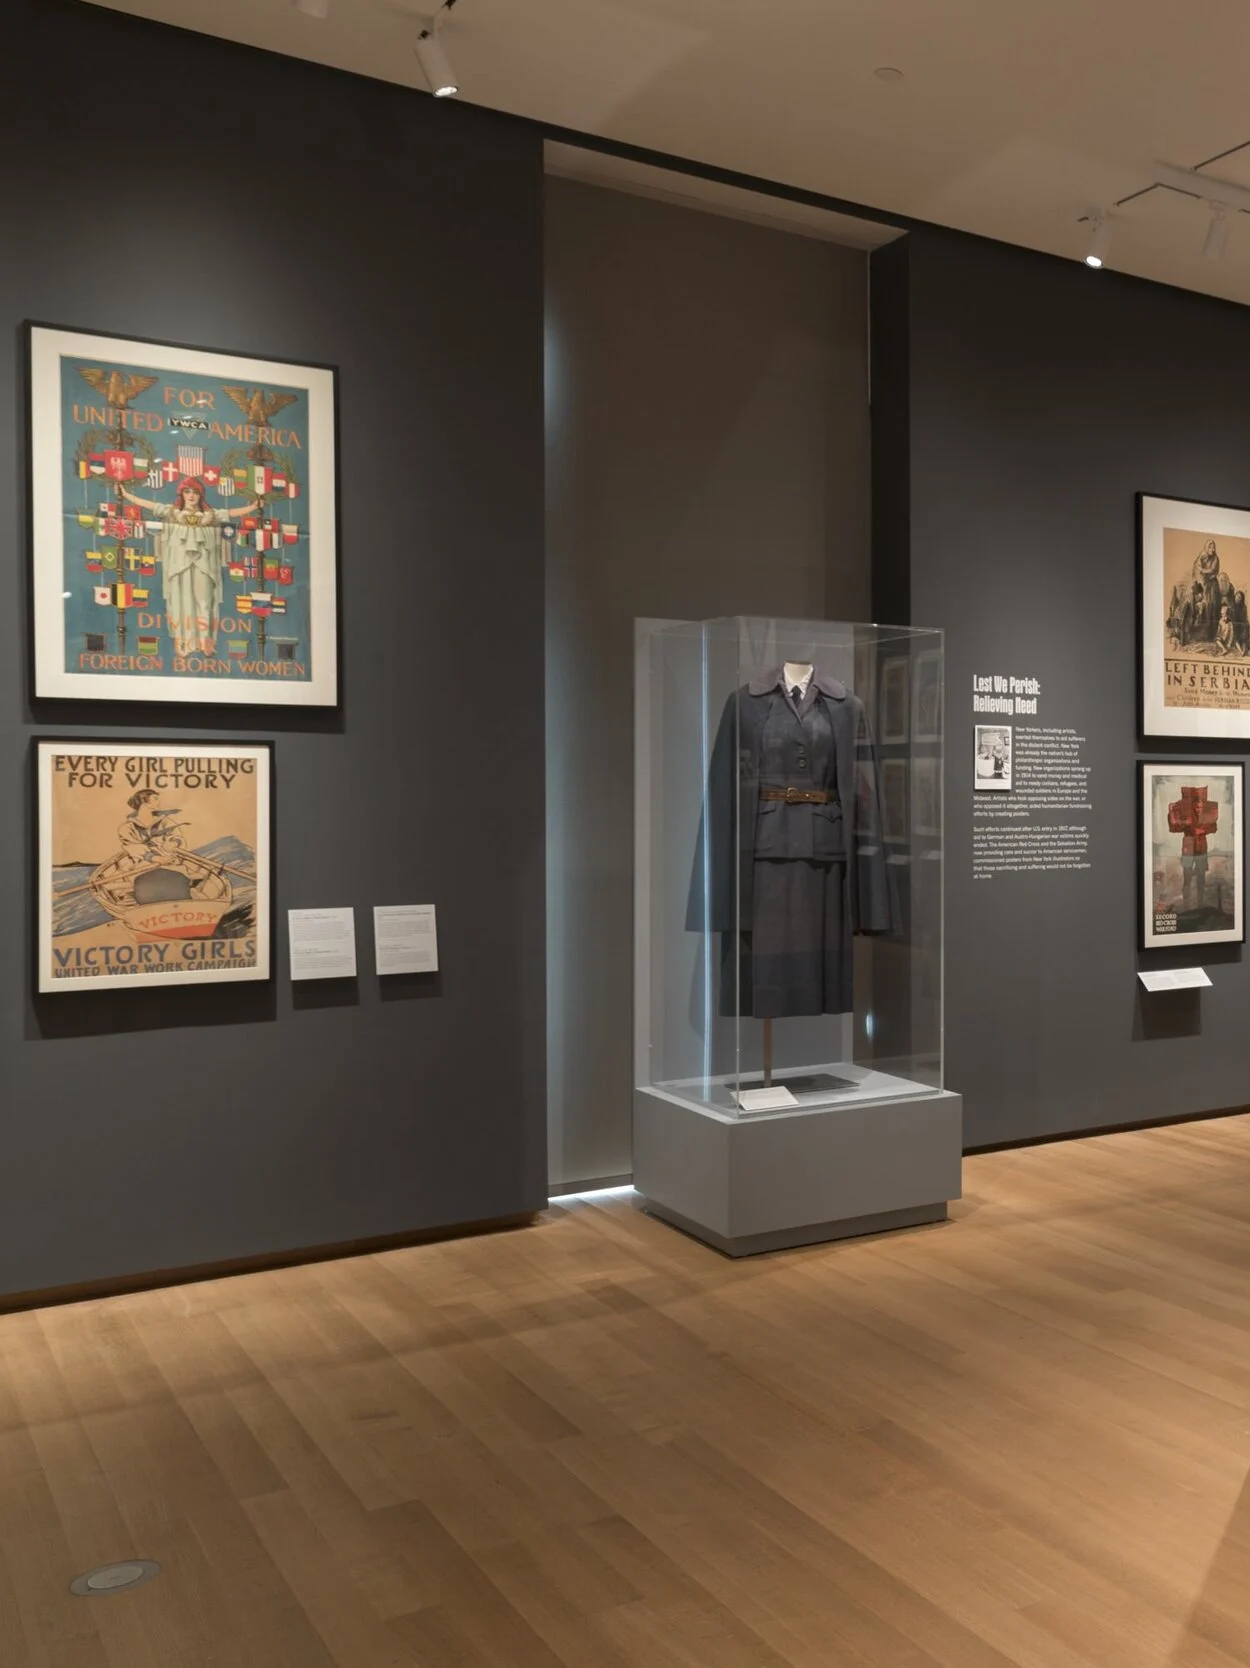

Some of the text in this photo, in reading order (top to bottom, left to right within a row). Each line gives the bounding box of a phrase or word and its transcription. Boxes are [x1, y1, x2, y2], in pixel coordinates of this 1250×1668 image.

[163, 385, 216, 410] FOR
[73, 403, 302, 450] UNITED YWCA AMERICA
[137, 611, 252, 633] DIVISION
[79, 653, 305, 677] FOREIGN BORN WOMEN
[1165, 661, 1198, 674] LEFT
[973, 674, 1041, 695] Lest We Perish:
[1167, 674, 1250, 690] IN SERBIA
[973, 694, 1037, 716] Relieving Need
[54, 755, 254, 775] EVERY GIRL PULLING
[68, 772, 236, 789] FOR VICTORY
[139, 912, 217, 929] VICTORY
[54, 940, 256, 967] VICTORY GIRLS
[54, 966, 101, 978] UNITED
[107, 964, 138, 976] WAR
[143, 961, 183, 974] WORK
